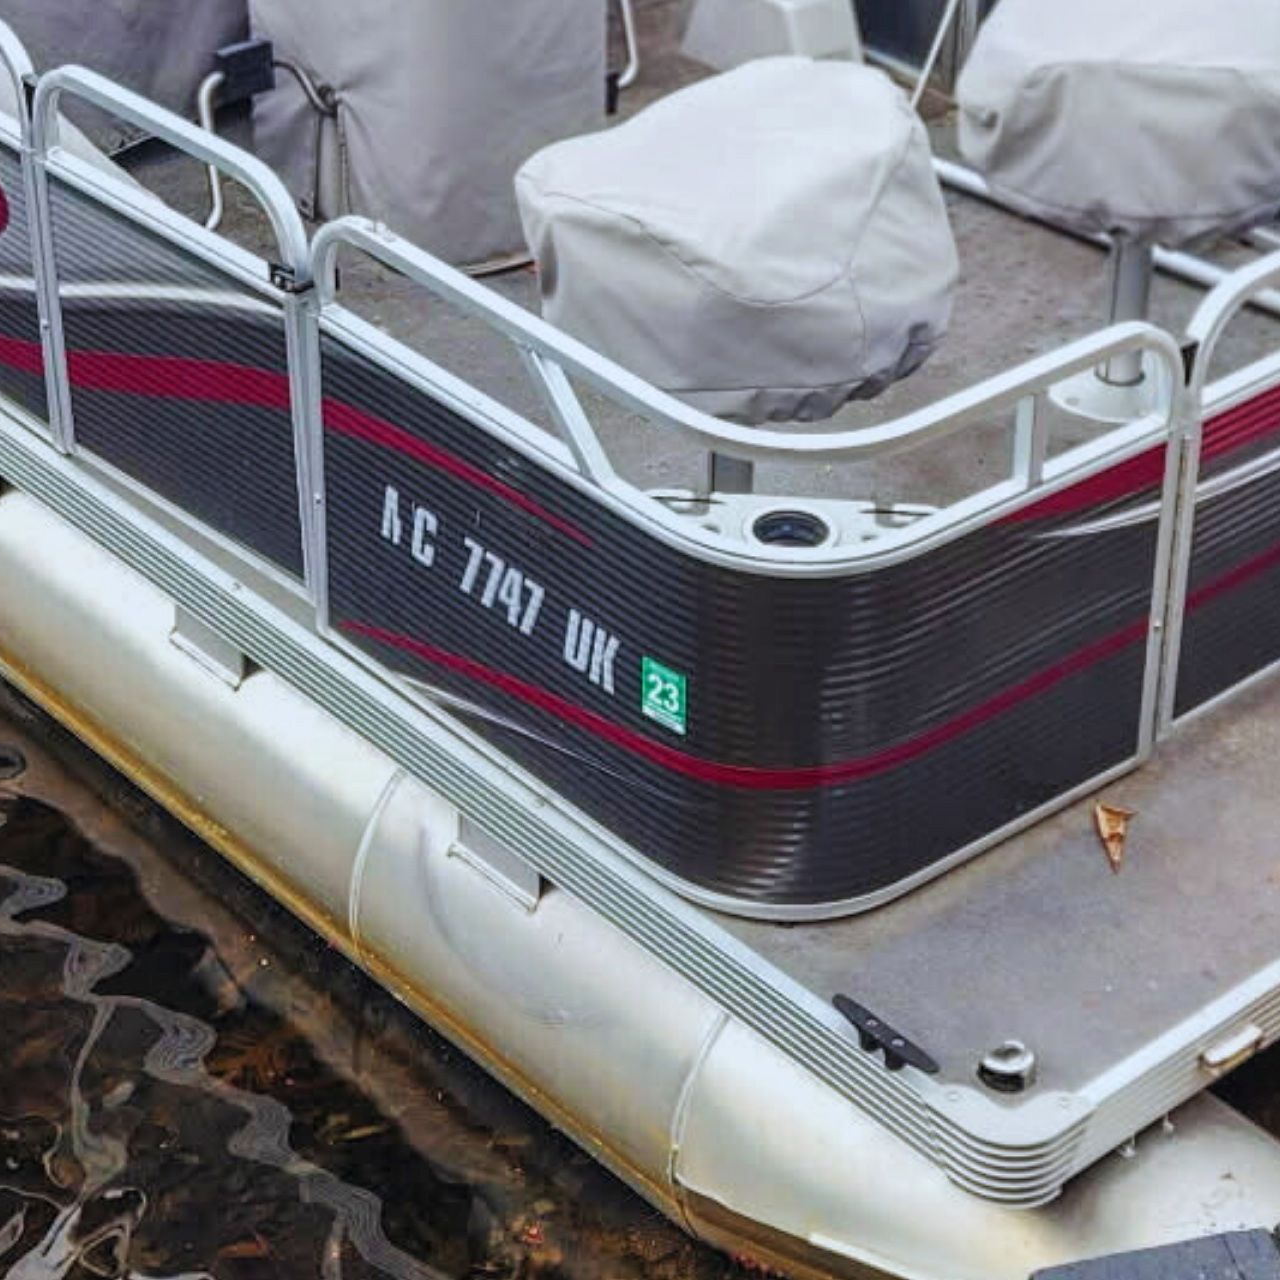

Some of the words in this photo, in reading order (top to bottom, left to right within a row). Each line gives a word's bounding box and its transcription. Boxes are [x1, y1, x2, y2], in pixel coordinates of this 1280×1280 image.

[459, 537, 545, 635] 7747
[563, 609, 620, 695] UK
[648, 673, 680, 713] 23
